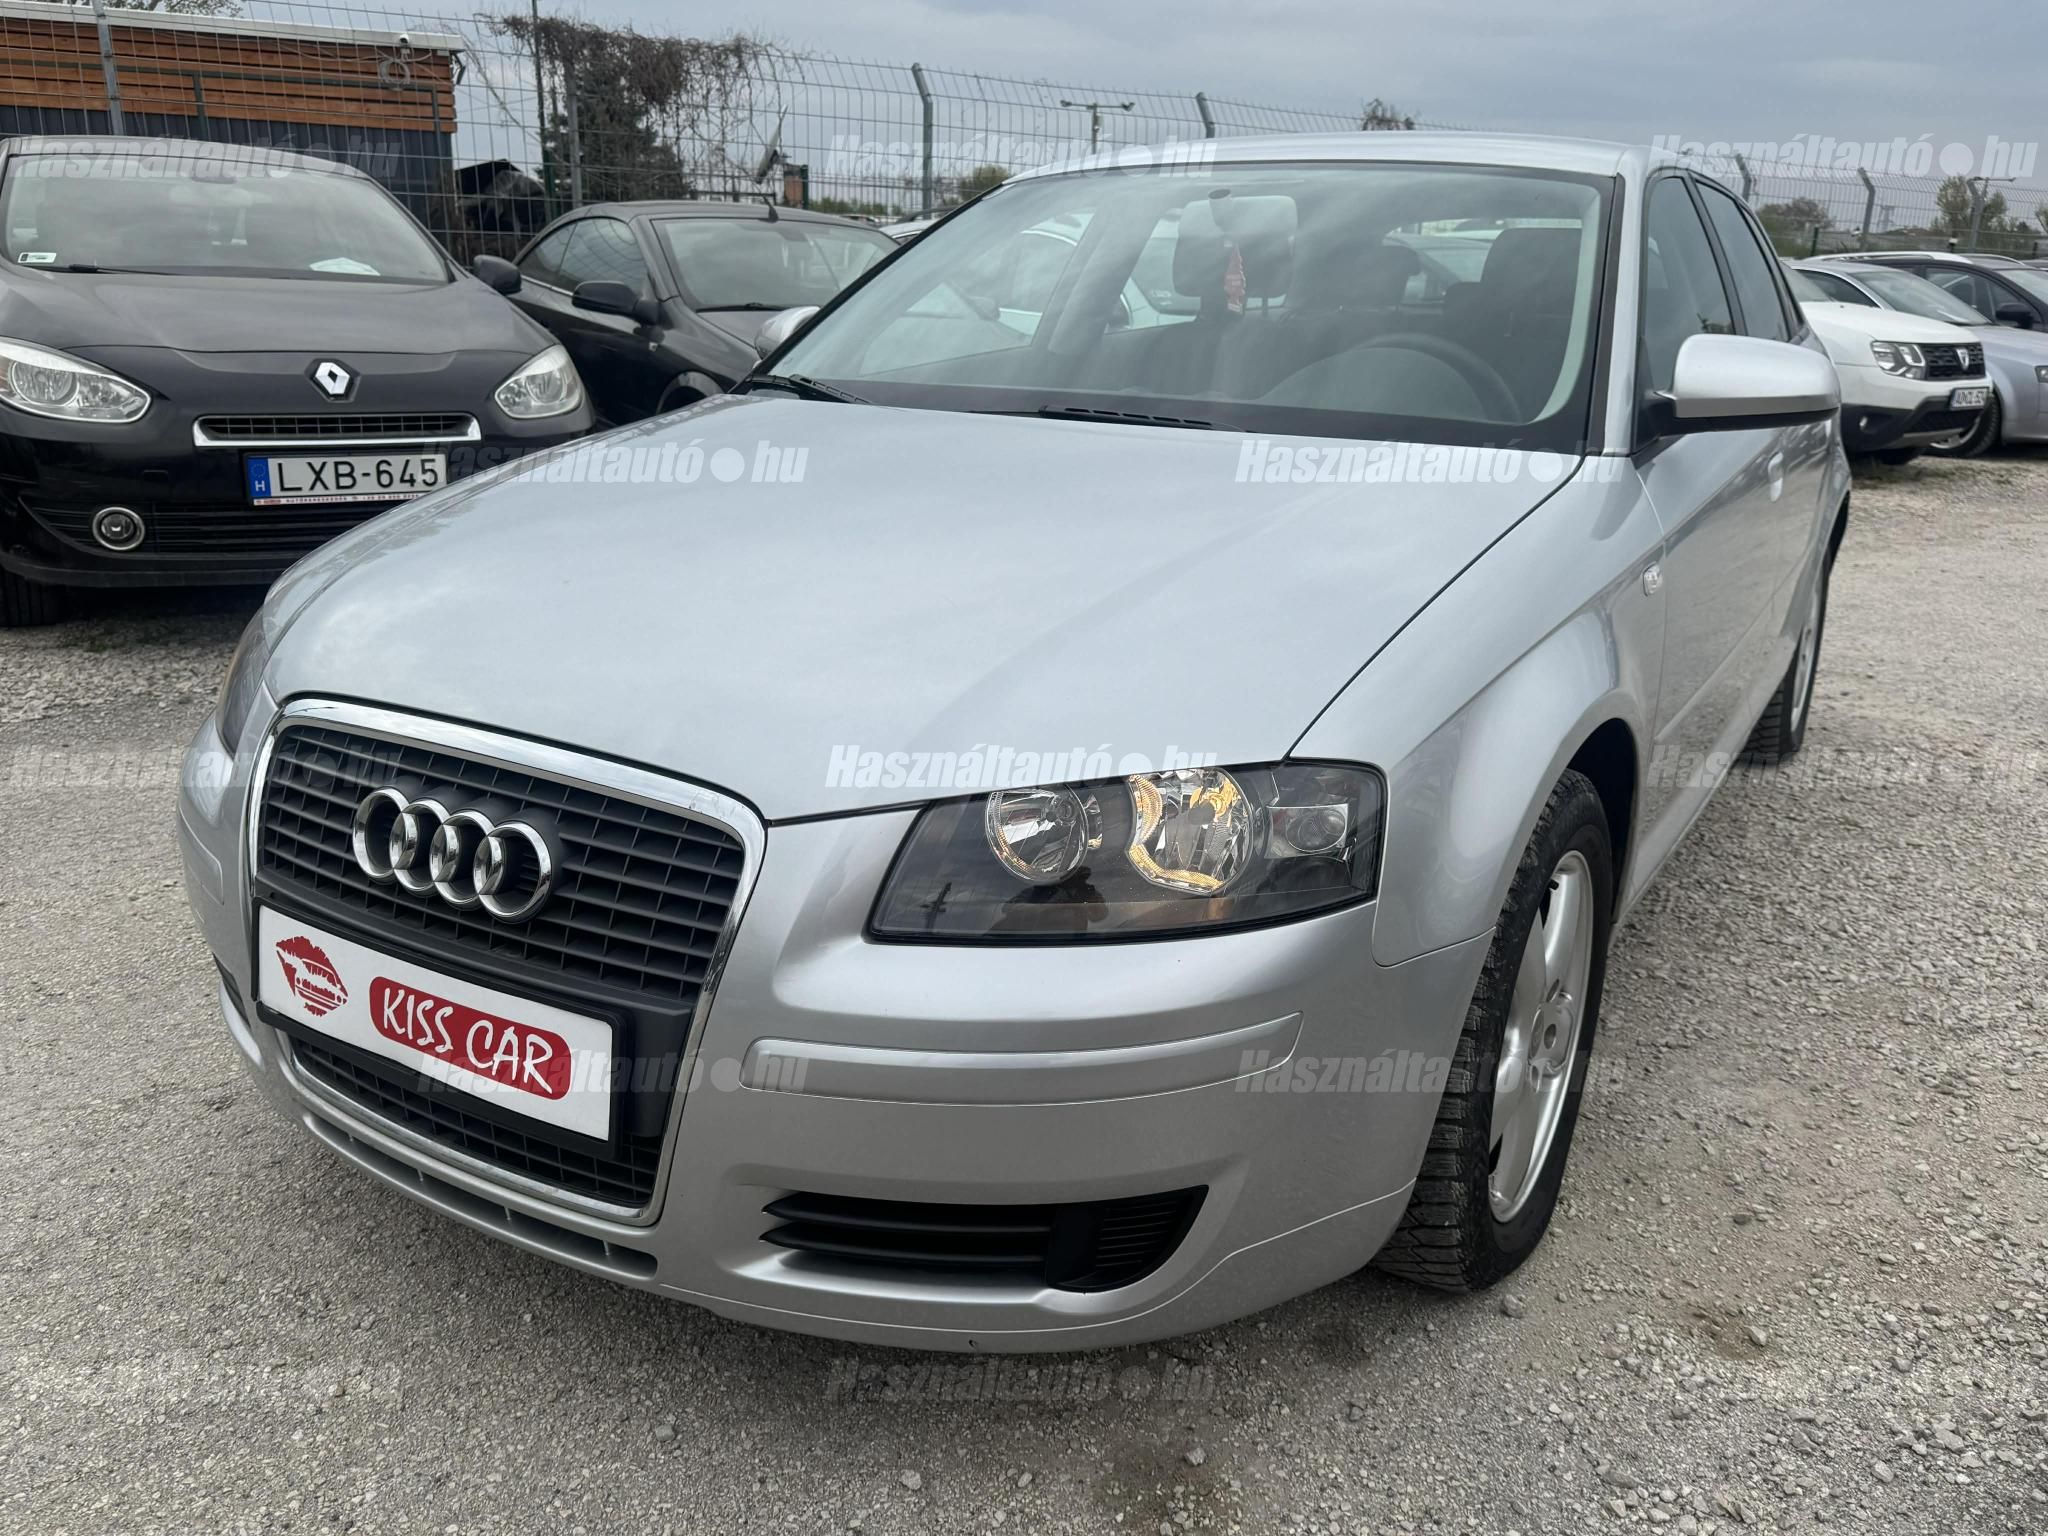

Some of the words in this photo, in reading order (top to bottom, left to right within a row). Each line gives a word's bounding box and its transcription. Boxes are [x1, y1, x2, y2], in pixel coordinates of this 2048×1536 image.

[255, 480, 265, 491] H
[277, 458, 439, 492] LXB-645
[383, 988, 454, 1053] KISS
[466, 1020, 553, 1094] CAR
